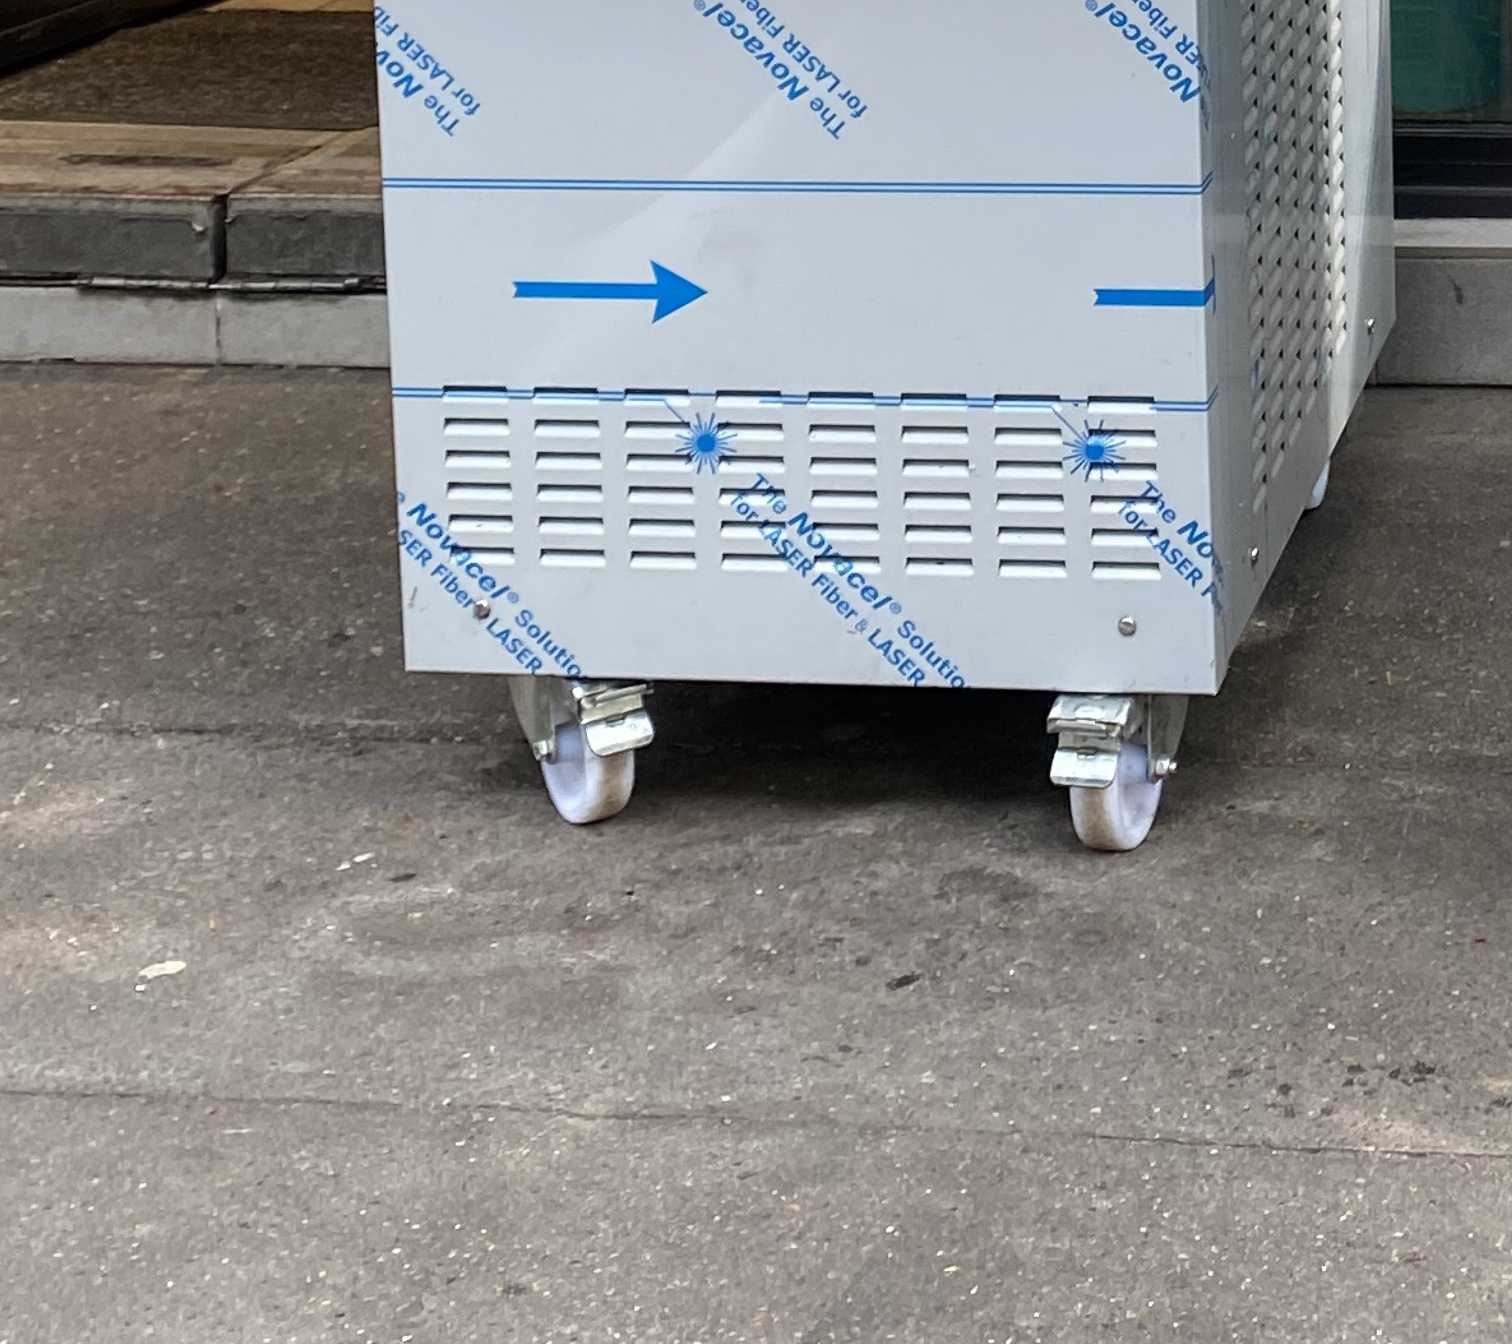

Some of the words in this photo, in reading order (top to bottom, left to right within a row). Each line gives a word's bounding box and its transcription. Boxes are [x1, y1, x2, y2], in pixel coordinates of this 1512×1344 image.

[396, 31, 455, 92] LASER
[782, 32, 841, 94] LASER
[424, 94, 460, 138] The
[450, 87, 481, 116] for
[809, 97, 846, 141] The
[838, 89, 868, 119] for
[430, 563, 478, 609] Fiber
[485, 616, 544, 675] LASER
[811, 572, 859, 620] Fiber
[866, 627, 927, 688] LASER
